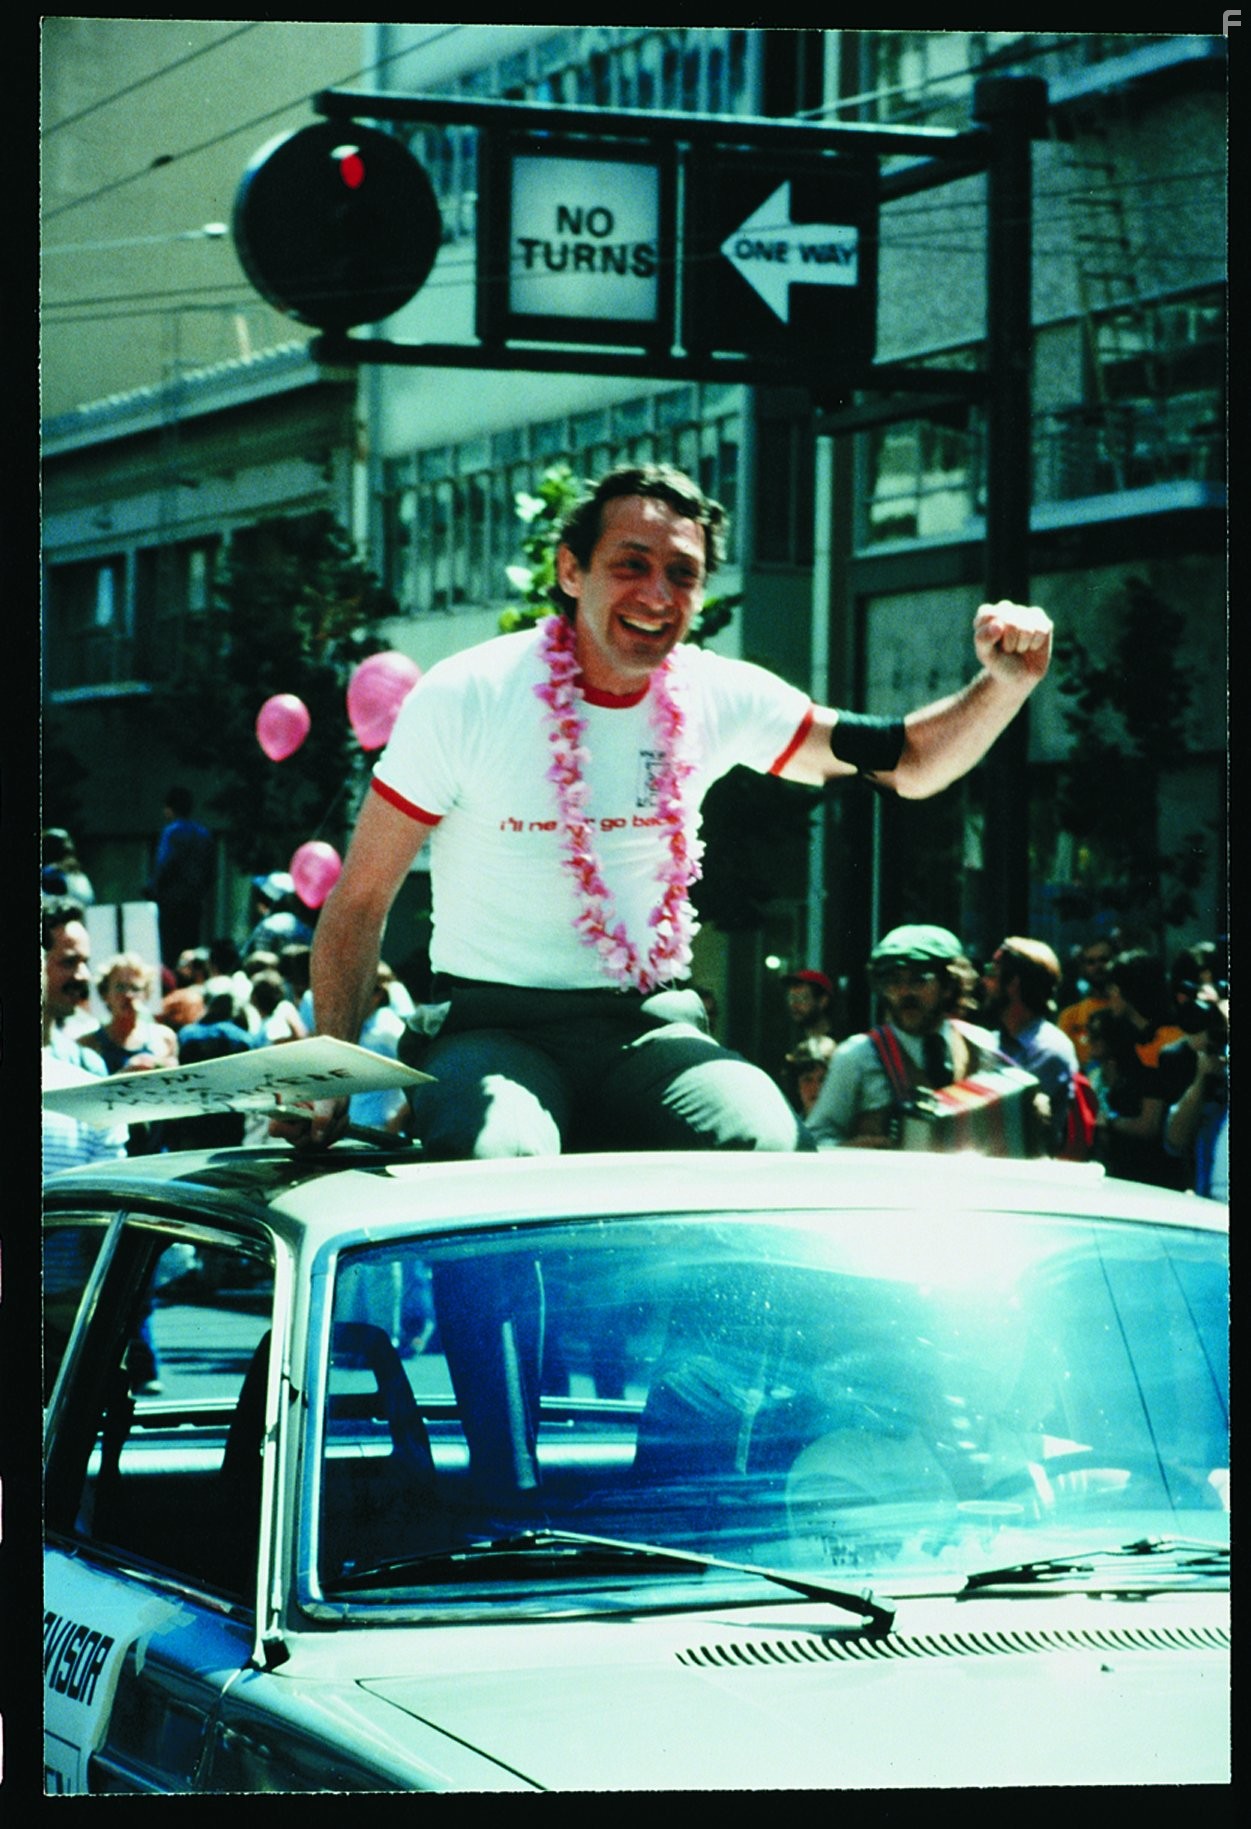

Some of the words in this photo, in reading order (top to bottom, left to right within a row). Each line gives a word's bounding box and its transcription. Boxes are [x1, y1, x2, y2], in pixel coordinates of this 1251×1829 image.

[556, 205, 614, 237] NO
[517, 238, 658, 278] TURNS
[735, 239, 788, 264] ONE
[799, 243, 856, 266] WAY
[529, 818, 595, 831] ner
[601, 818, 626, 832] go
[633, 815, 680, 828] bac
